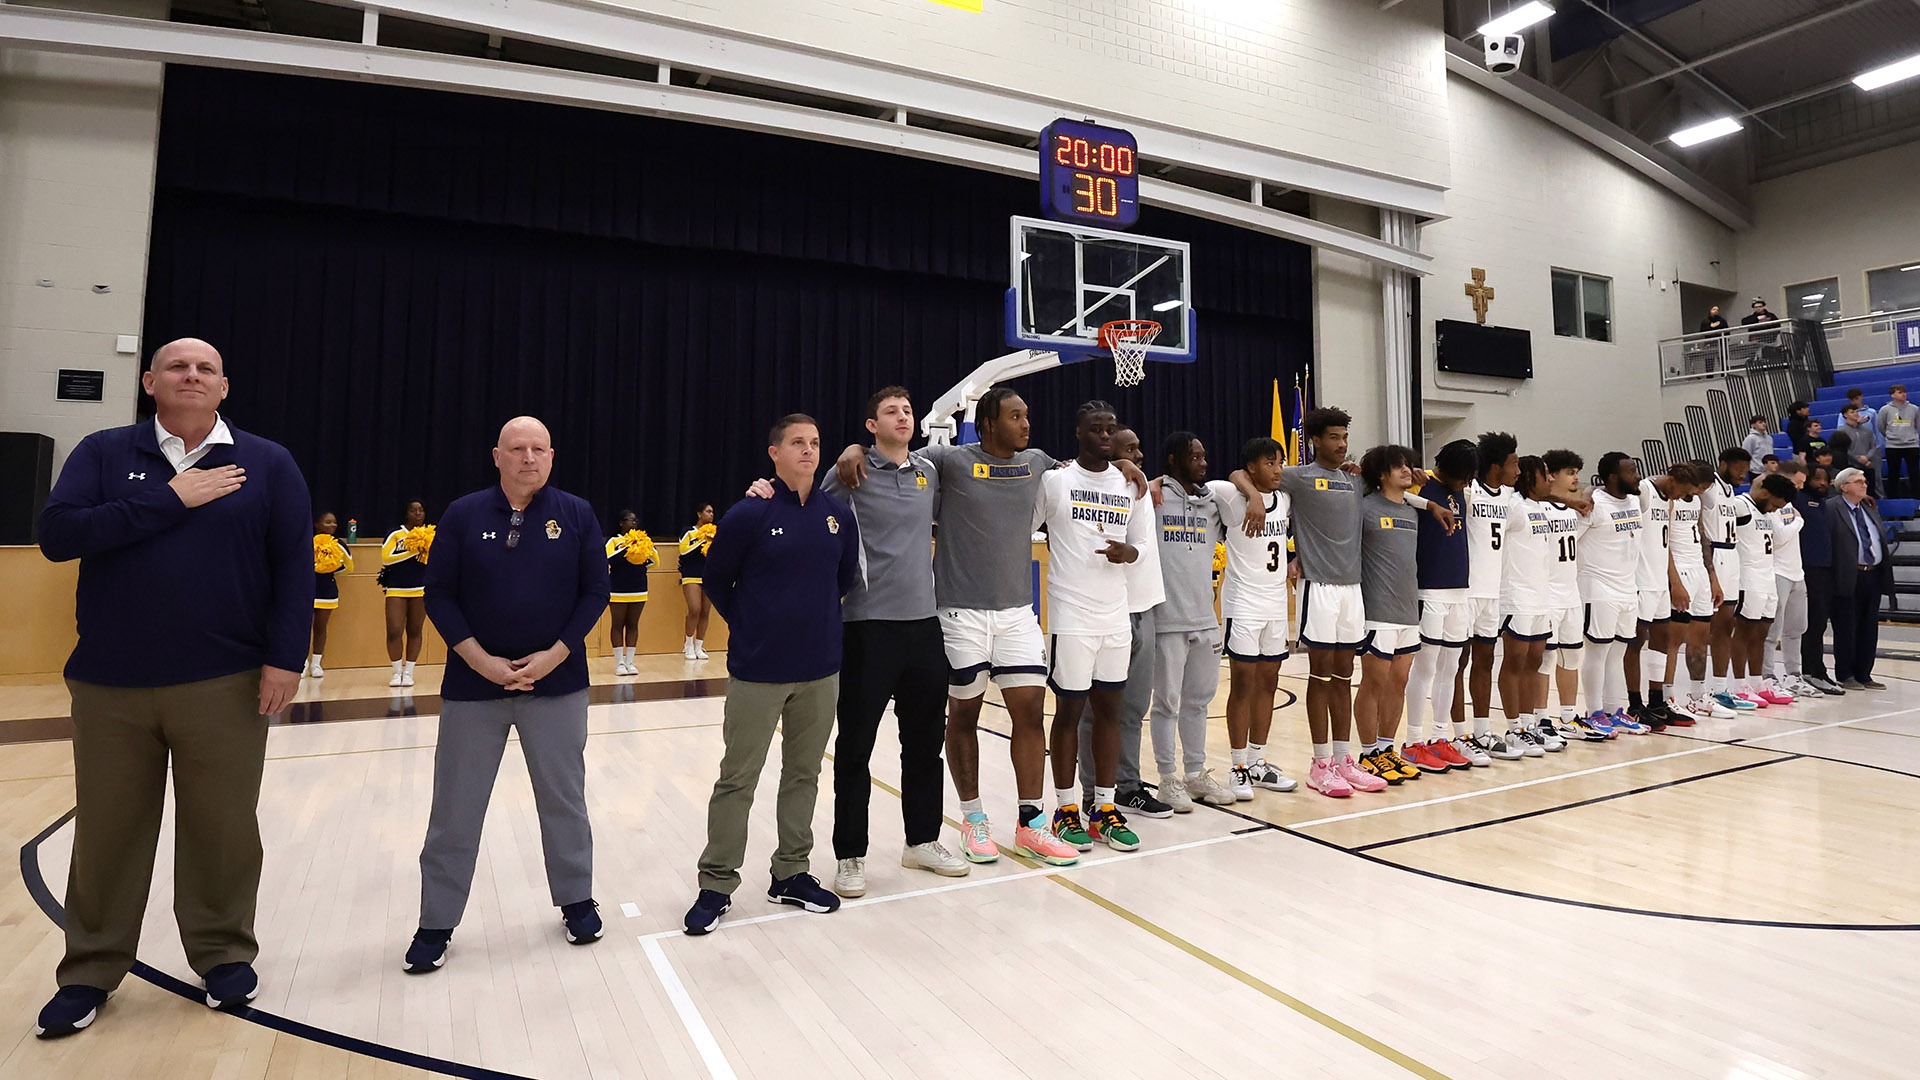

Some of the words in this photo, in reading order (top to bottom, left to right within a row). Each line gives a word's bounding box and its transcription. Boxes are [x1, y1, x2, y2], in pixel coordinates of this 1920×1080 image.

[1057, 135, 1132, 175] 20:00
[1075, 173, 1117, 216] 30
[1070, 489, 1100, 504] NEUMANN
[1101, 493, 1131, 509] UNIVERSITY
[1072, 507, 1128, 526] BASKETBALL
[1471, 503, 1508, 519] NEUMAN
[1261, 519, 1287, 537] UMAN
[1532, 525, 1550, 535] BASKET
[1547, 518, 1578, 533] NEUMAN
[1490, 522, 1502, 551] 5
[1764, 533, 1774, 554] 2
[1266, 541, 1280, 572] 3
[1558, 535, 1576, 562] 10
